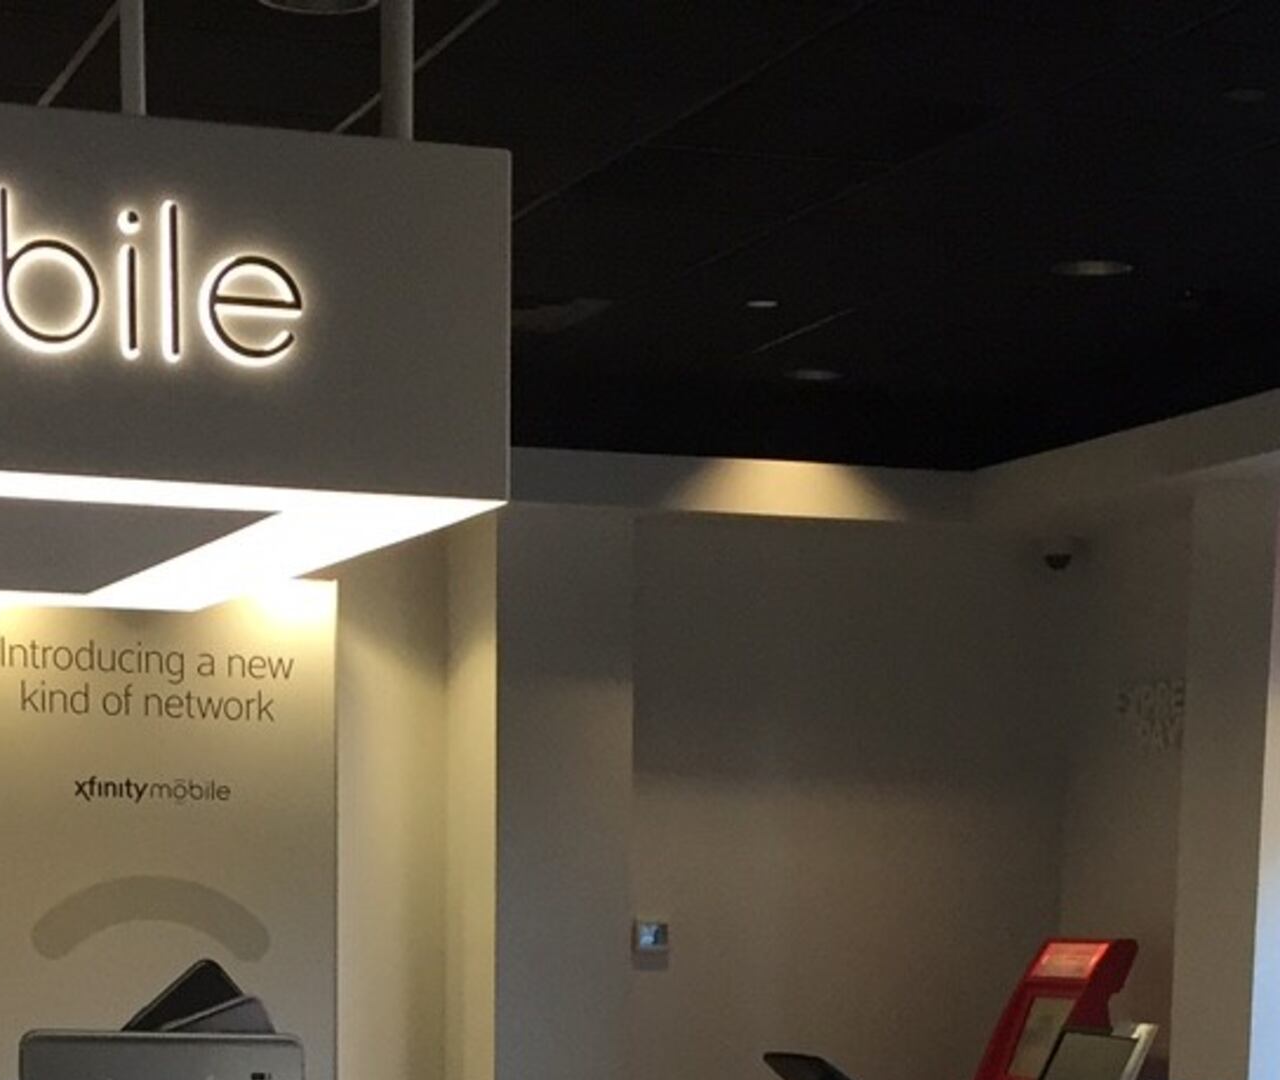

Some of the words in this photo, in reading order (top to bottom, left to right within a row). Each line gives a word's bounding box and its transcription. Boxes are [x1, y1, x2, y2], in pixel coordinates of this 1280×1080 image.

[0, 636, 185, 685] Introducing
[197, 652, 216, 677] a
[227, 652, 295, 680] new
[20, 680, 90, 715] kind
[102, 684, 133, 716] of
[144, 689, 275, 722] network
